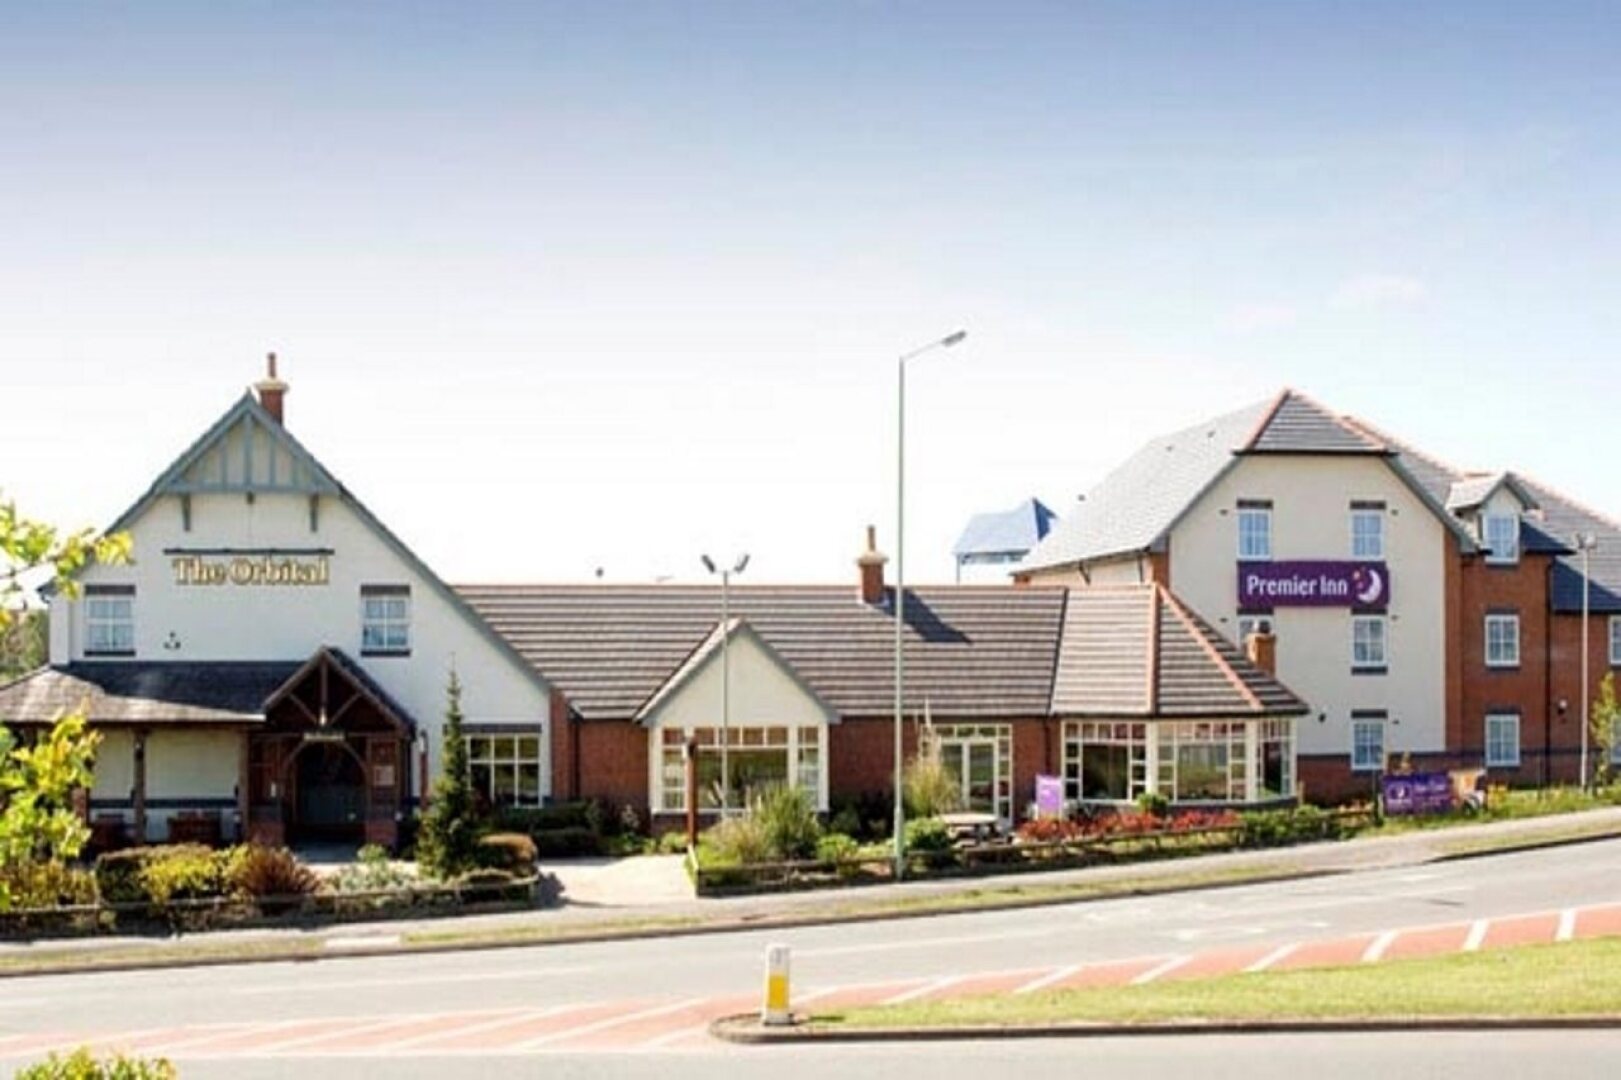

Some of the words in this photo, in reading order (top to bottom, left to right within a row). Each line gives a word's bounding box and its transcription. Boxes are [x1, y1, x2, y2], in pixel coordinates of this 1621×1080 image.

[173, 556, 226, 586] The
[229, 556, 330, 586] Orbital
[1246, 574, 1318, 597] Premier
[1320, 575, 1349, 596] Inn
